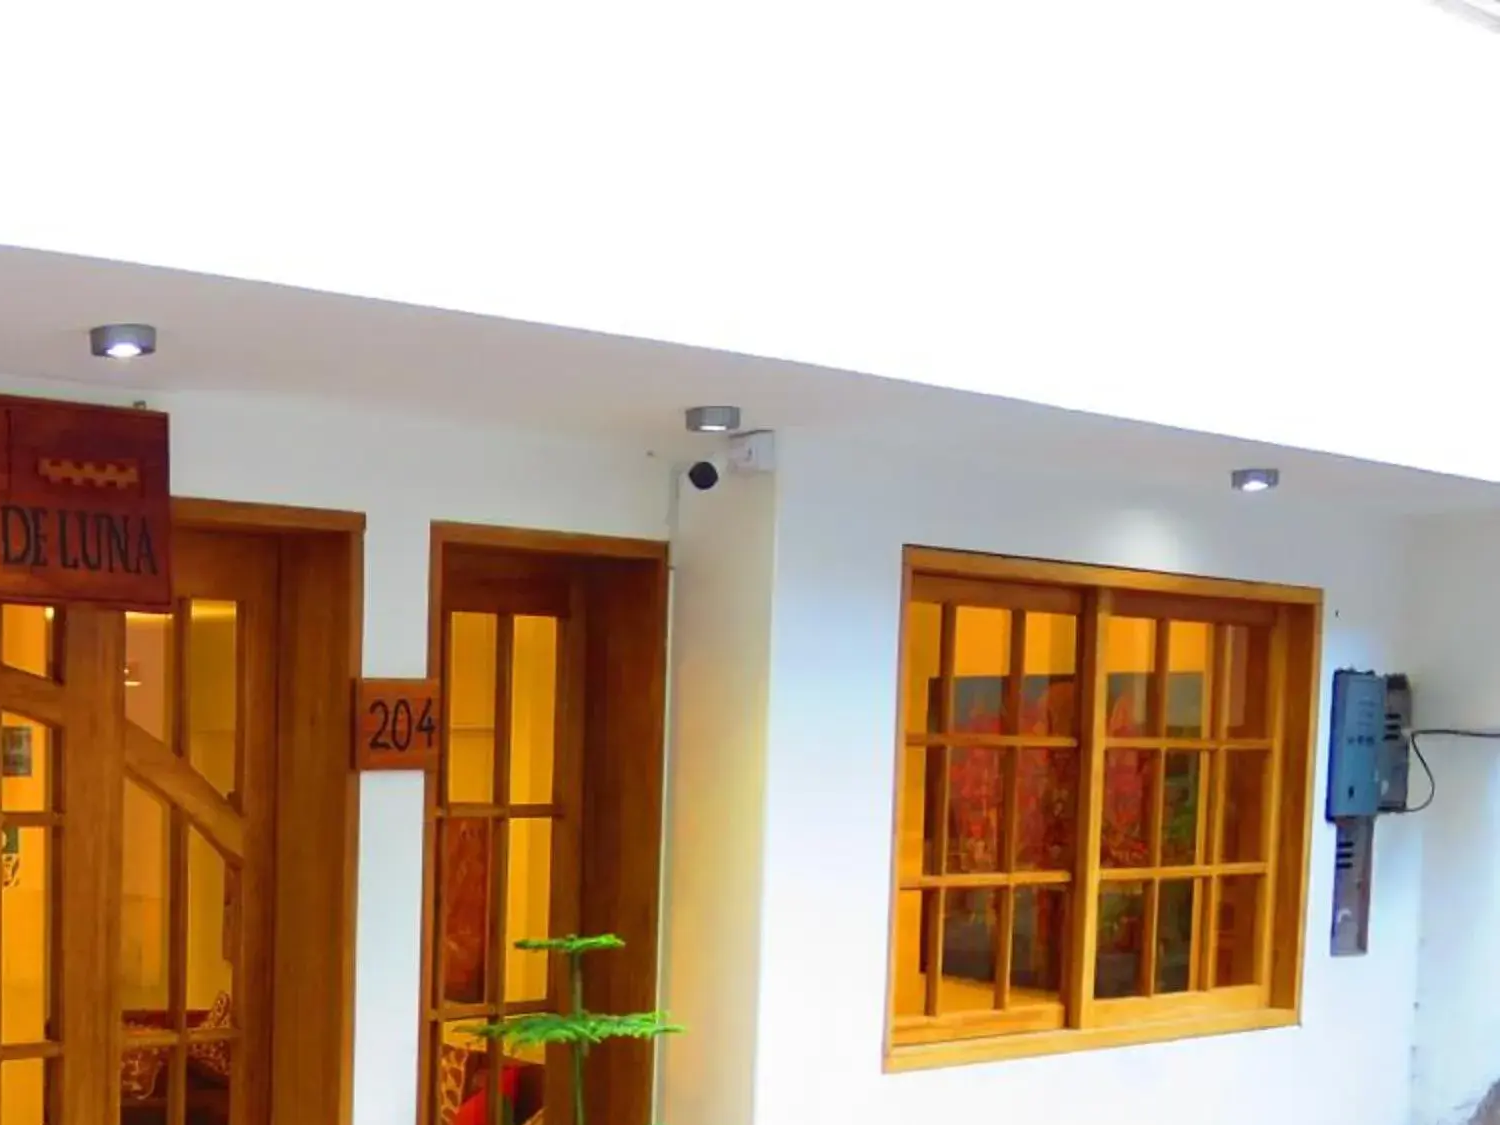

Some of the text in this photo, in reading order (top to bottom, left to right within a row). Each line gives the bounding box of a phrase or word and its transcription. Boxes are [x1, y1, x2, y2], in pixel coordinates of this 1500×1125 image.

[1, 504, 49, 567] DE
[56, 509, 160, 576] LUNA
[368, 696, 436, 752] 204
